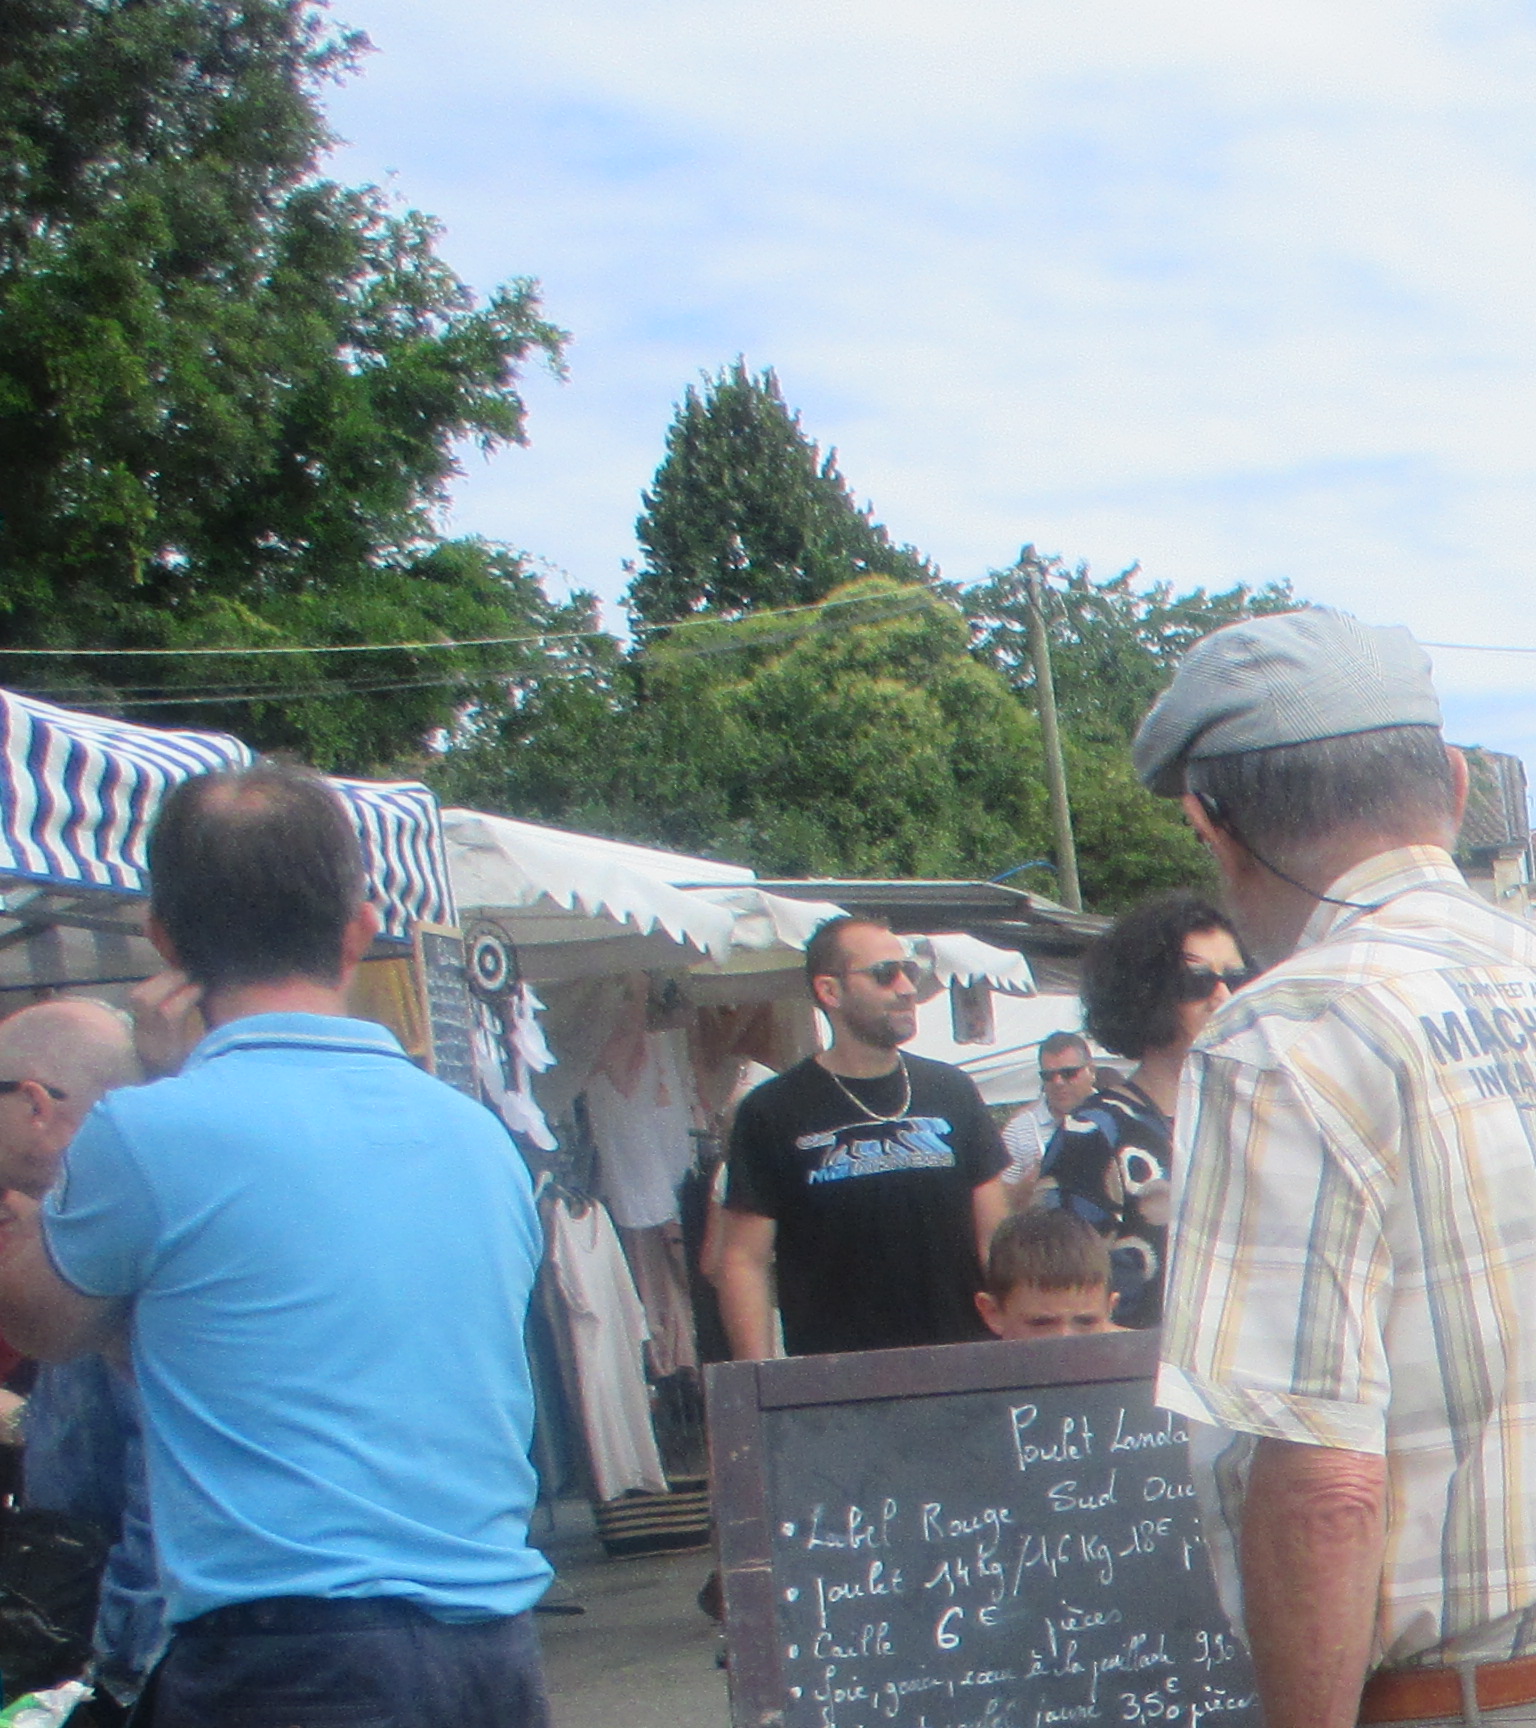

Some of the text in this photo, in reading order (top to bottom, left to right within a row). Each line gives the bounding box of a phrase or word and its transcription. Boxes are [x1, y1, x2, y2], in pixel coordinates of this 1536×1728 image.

[1010, 1404, 1094, 1471] Poulet
[923, 1503, 1014, 1555] Rouge
[1048, 1468, 1117, 1511] Sud
[814, 1621, 896, 1658] Caille
